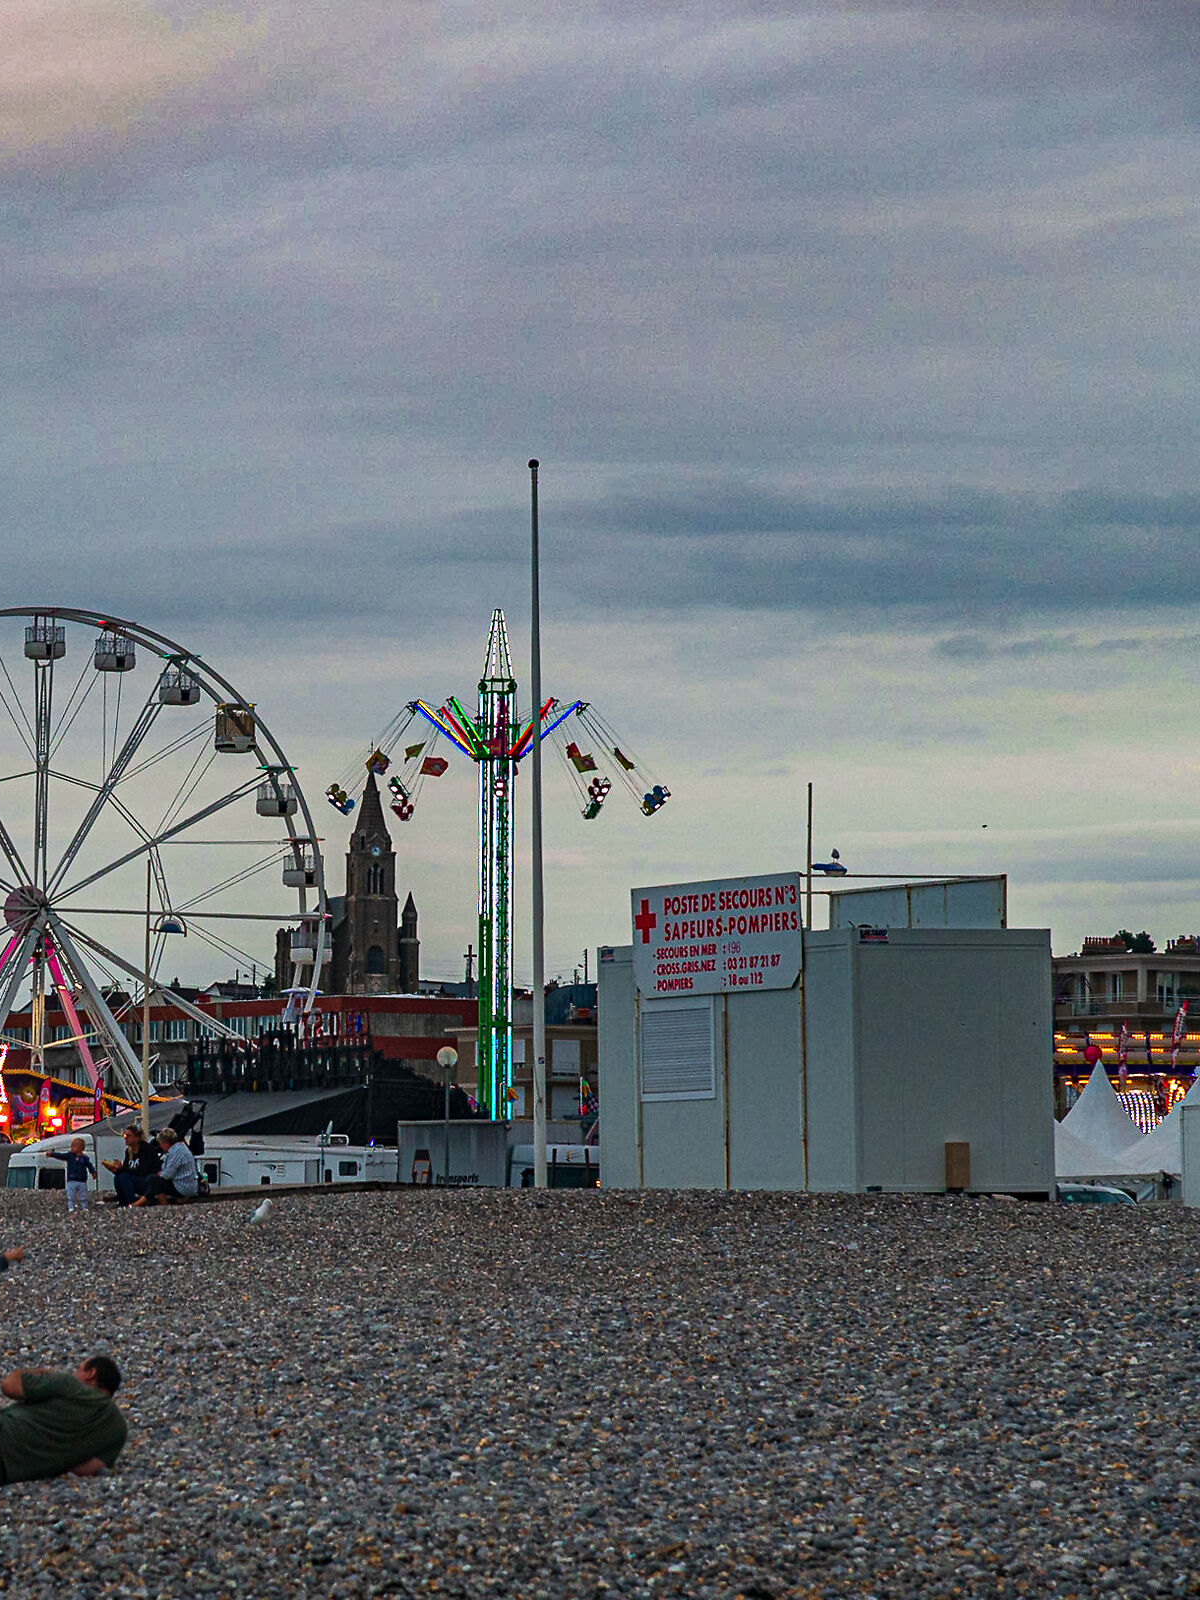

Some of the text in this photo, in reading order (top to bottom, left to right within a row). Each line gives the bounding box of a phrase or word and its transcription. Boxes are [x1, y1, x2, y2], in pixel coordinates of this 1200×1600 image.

[663, 894, 699, 916] POSTE
[701, 891, 716, 912] DE
[718, 886, 772, 911] SECOURS
[663, 910, 798, 942] SAPEURS-POMPIERS
[689, 945, 700, 957] EN
[701, 943, 718, 956] MER
[727, 957, 737, 970] 03
[738, 956, 747, 969] 21
[749, 955, 760, 969] 87
[760, 954, 769, 968] 21
[771, 953, 781, 967] 87
[728, 973, 738, 987] 18
[738, 976, 749, 986] ou
[750, 971, 764, 985] 112
